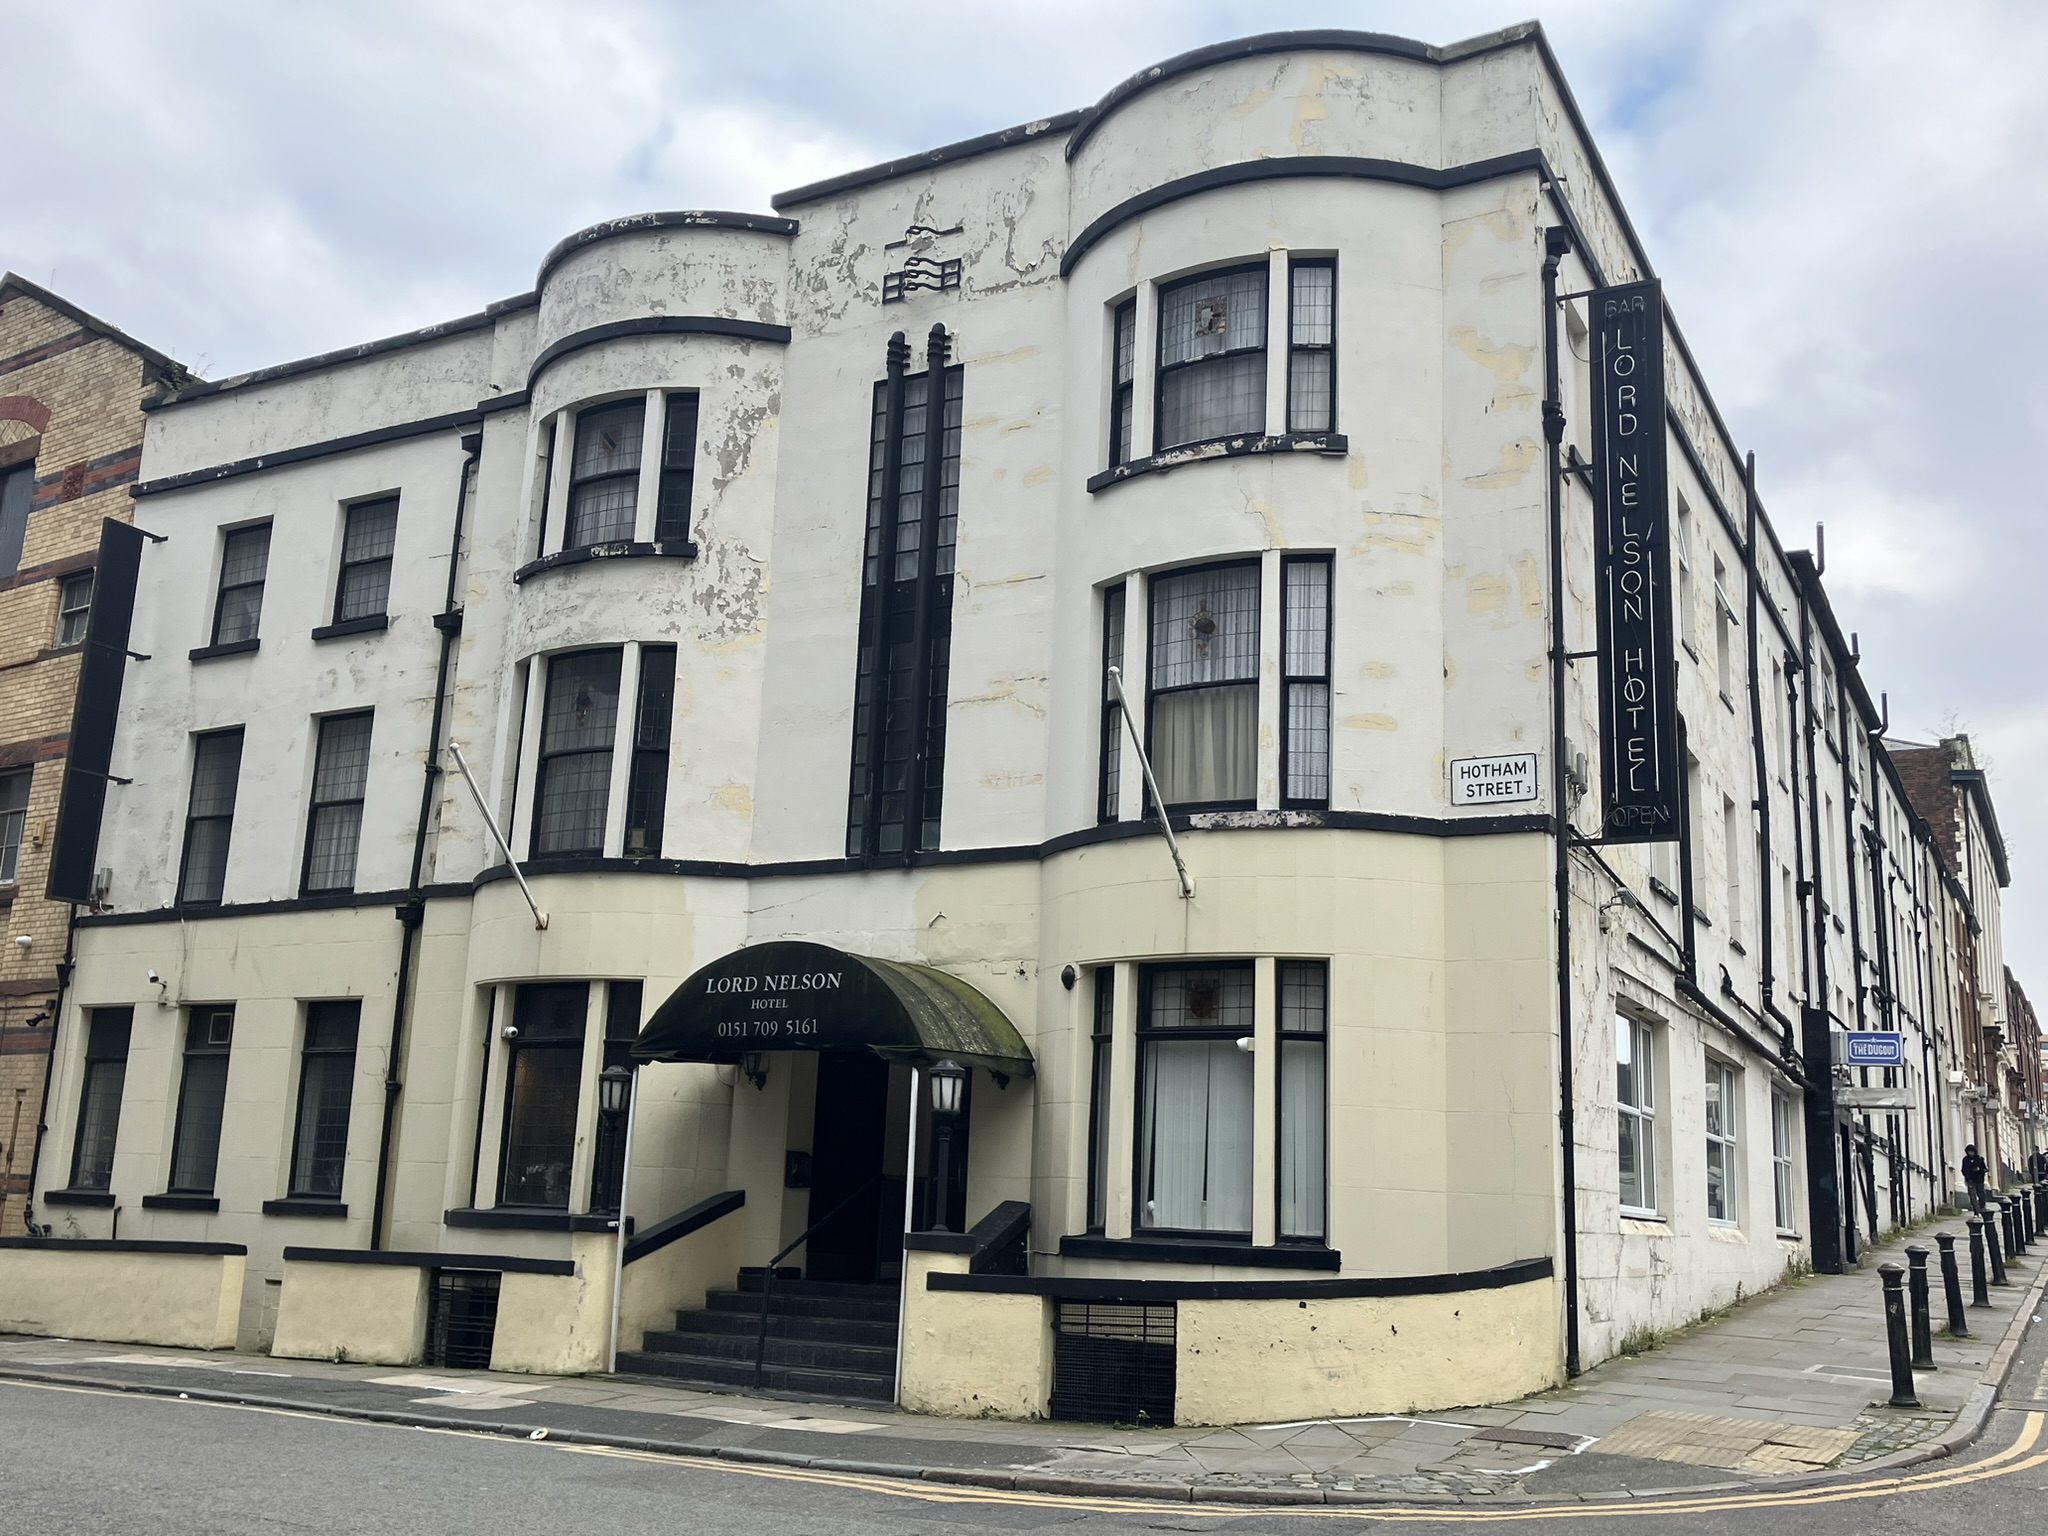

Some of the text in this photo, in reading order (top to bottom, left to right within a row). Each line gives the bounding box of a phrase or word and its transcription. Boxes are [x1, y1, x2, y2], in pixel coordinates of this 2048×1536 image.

[1604, 295, 1645, 318] BAR
[1613, 328, 1646, 792] LORD NELSON HOTEL
[1460, 760, 1527, 780] HOTHAM
[1466, 780, 1532, 798] STREET 3
[1611, 804, 1671, 827] OPEN
[705, 972, 843, 994] LORD NELSON
[750, 998, 789, 1010] HOTEL
[718, 1017, 818, 1037] 0151 709 5161
[1853, 1044, 1894, 1055] THE DUGOUT
